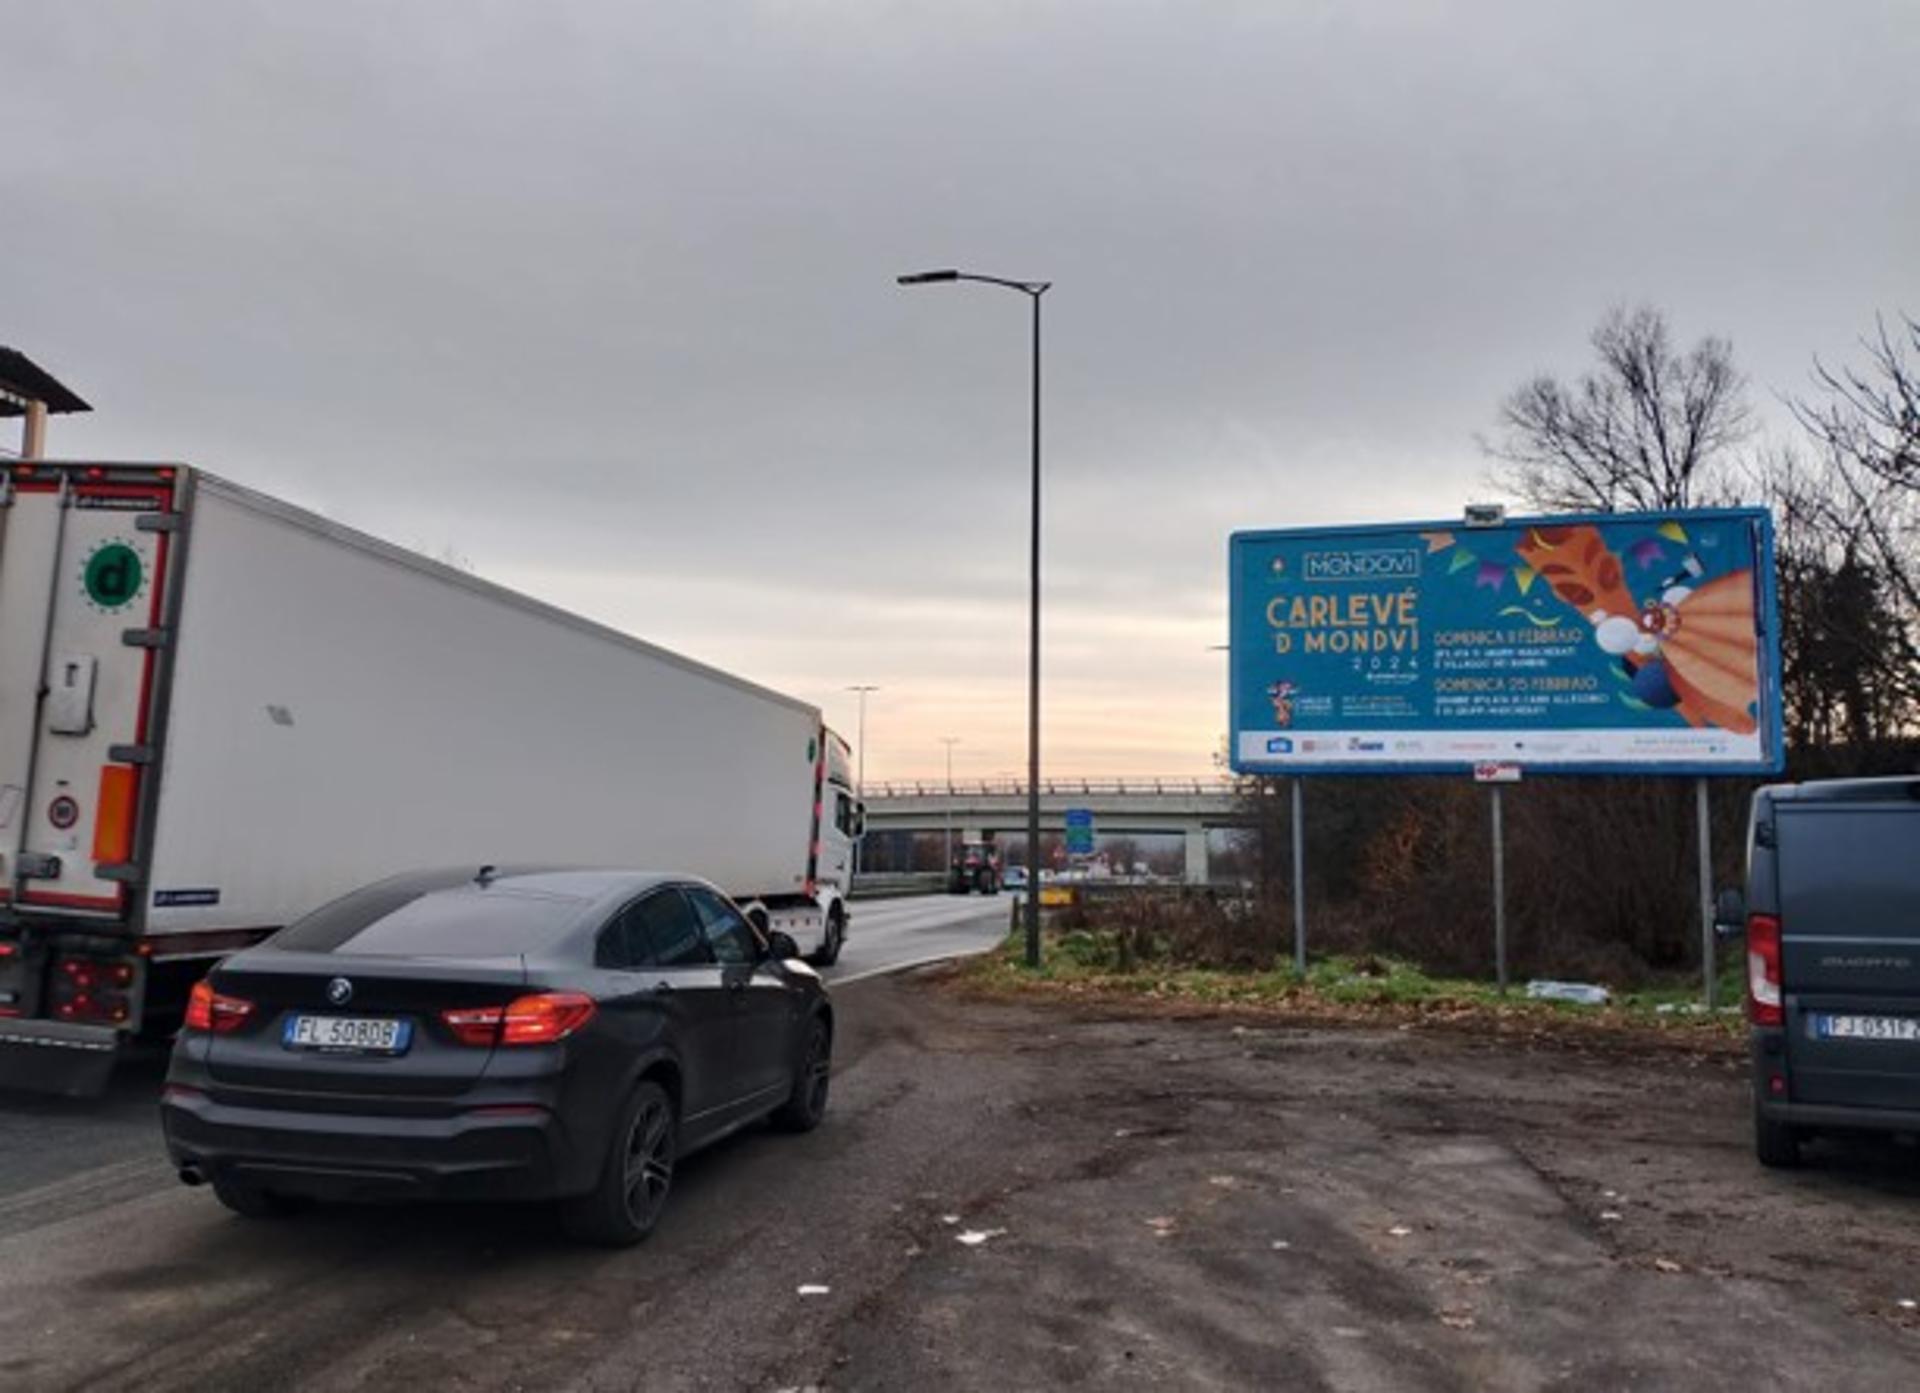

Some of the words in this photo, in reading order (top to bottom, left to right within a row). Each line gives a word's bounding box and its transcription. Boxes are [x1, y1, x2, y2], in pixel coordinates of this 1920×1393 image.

[1266, 586, 1419, 628] CARLEVÉ
[1434, 678, 1504, 691] DOMENICA
[1532, 675, 1598, 690] FEBBRAIO
[297, 1017, 320, 1042] FL
